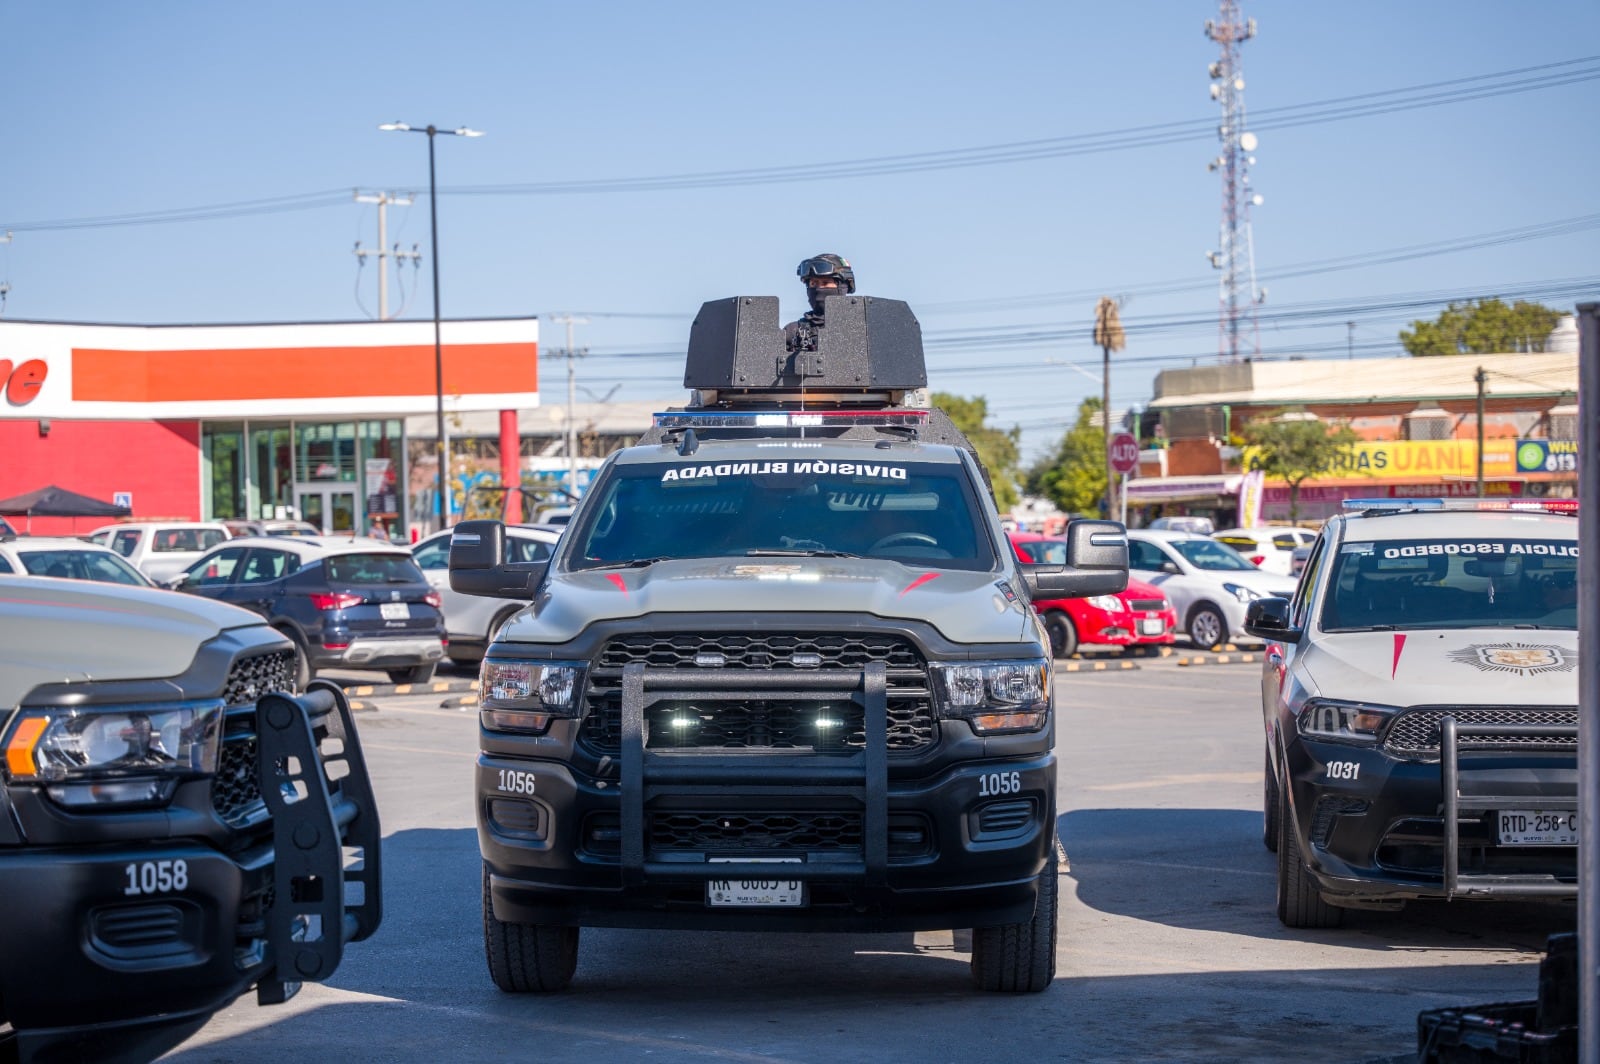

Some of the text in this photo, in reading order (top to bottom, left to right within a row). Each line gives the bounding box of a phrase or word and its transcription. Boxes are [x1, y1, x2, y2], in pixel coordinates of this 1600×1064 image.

[1110, 444, 1137, 461] ALTO
[1393, 446, 1471, 471] UANL
[1395, 485, 1449, 497] INGRESA
[497, 769, 536, 795] 1056
[1326, 760, 1361, 780] 1031
[978, 771, 1021, 797] 1056
[124, 859, 188, 895] 1058
